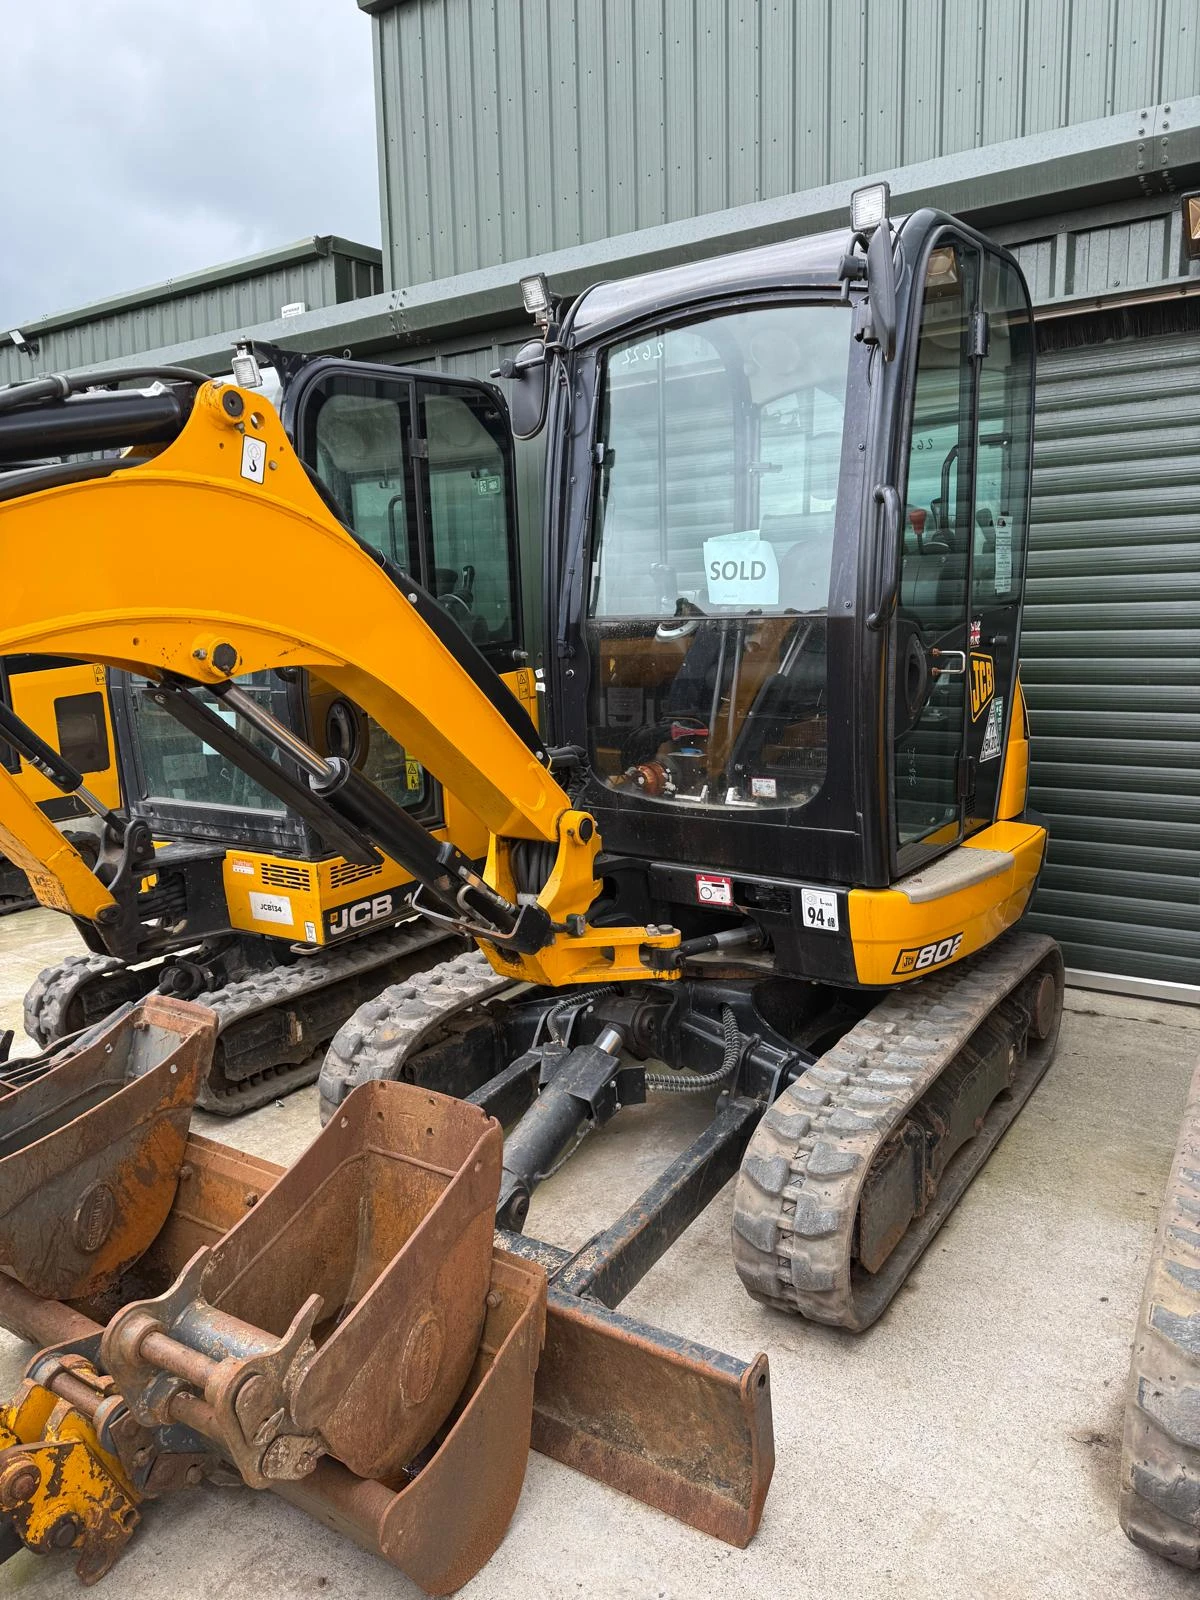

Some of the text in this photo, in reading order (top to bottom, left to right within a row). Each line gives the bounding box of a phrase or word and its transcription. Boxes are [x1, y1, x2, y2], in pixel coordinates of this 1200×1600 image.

[710, 561, 767, 581] SOLD
[972, 660, 993, 713] JCB
[260, 903, 283, 913] JCB134
[330, 894, 393, 935] JCB
[807, 906, 836, 928] 94 dB
